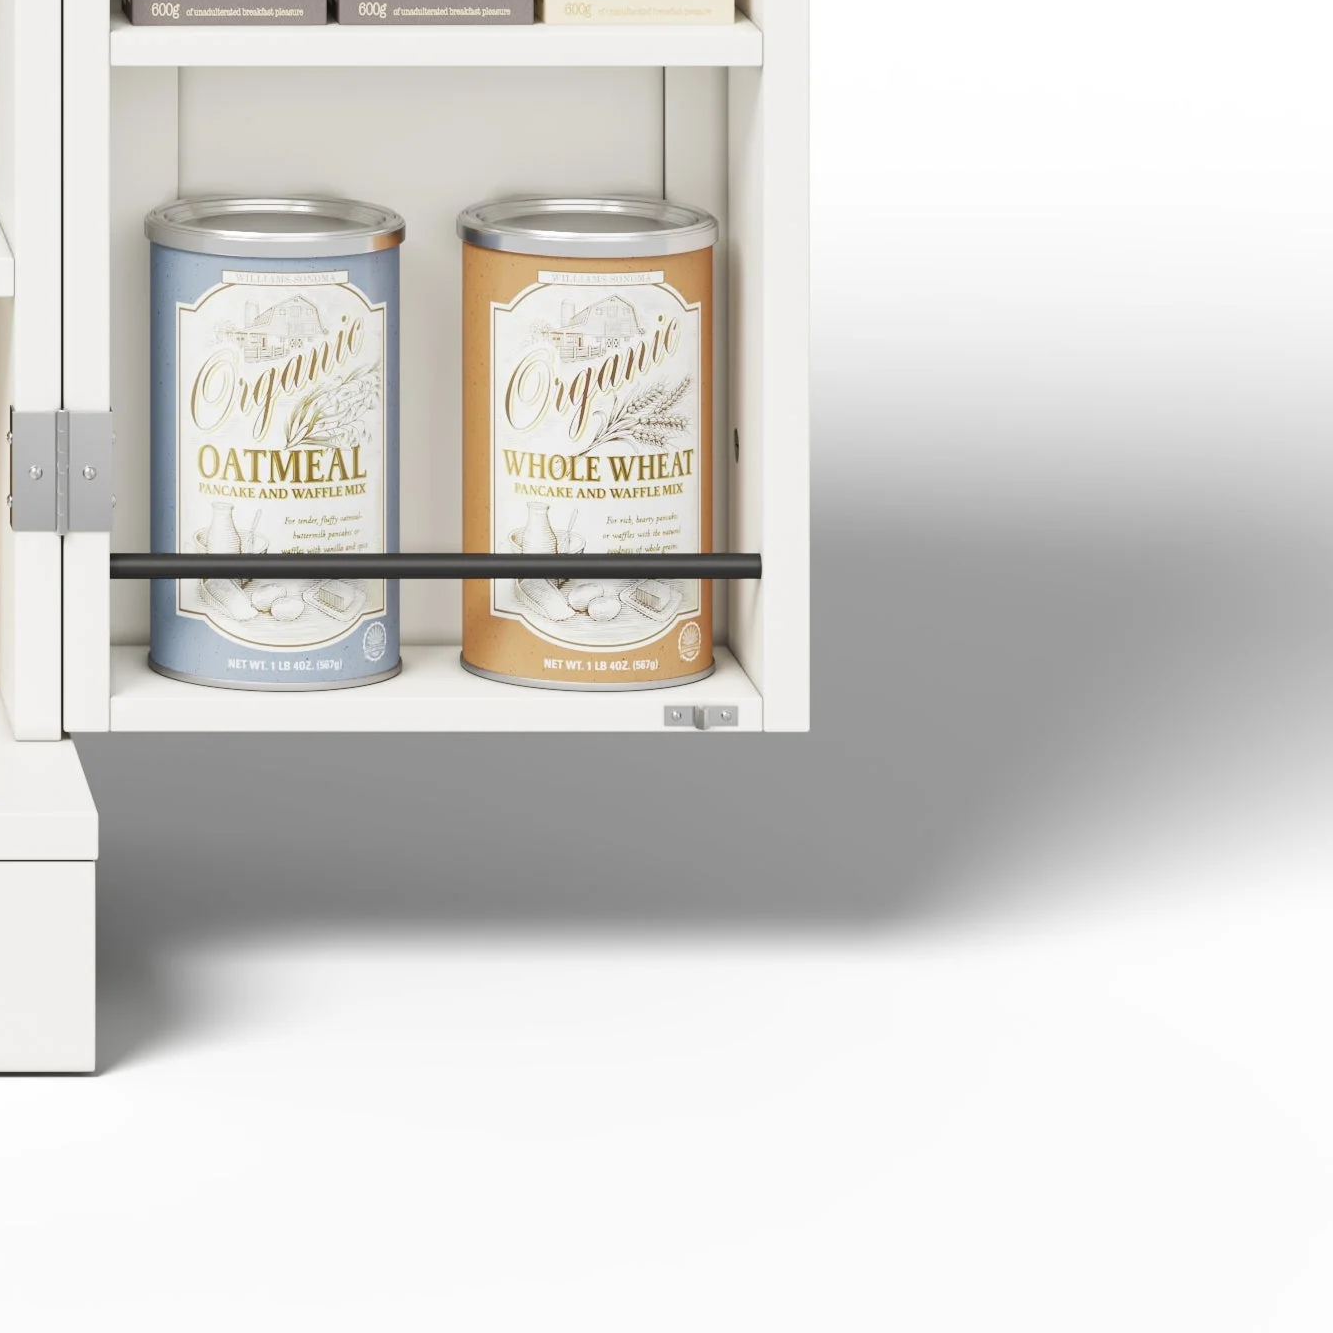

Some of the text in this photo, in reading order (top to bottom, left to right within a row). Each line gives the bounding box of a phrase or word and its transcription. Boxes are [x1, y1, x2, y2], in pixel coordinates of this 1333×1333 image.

[151, 2, 180, 20] 600g
[190, 315, 365, 442] Organic
[505, 315, 681, 442] Organic
[197, 444, 367, 483] OATMEAL
[503, 448, 694, 482] WHOLE WHEAT
[198, 483, 367, 500] PANCAKE AND WAFFLE MIX
